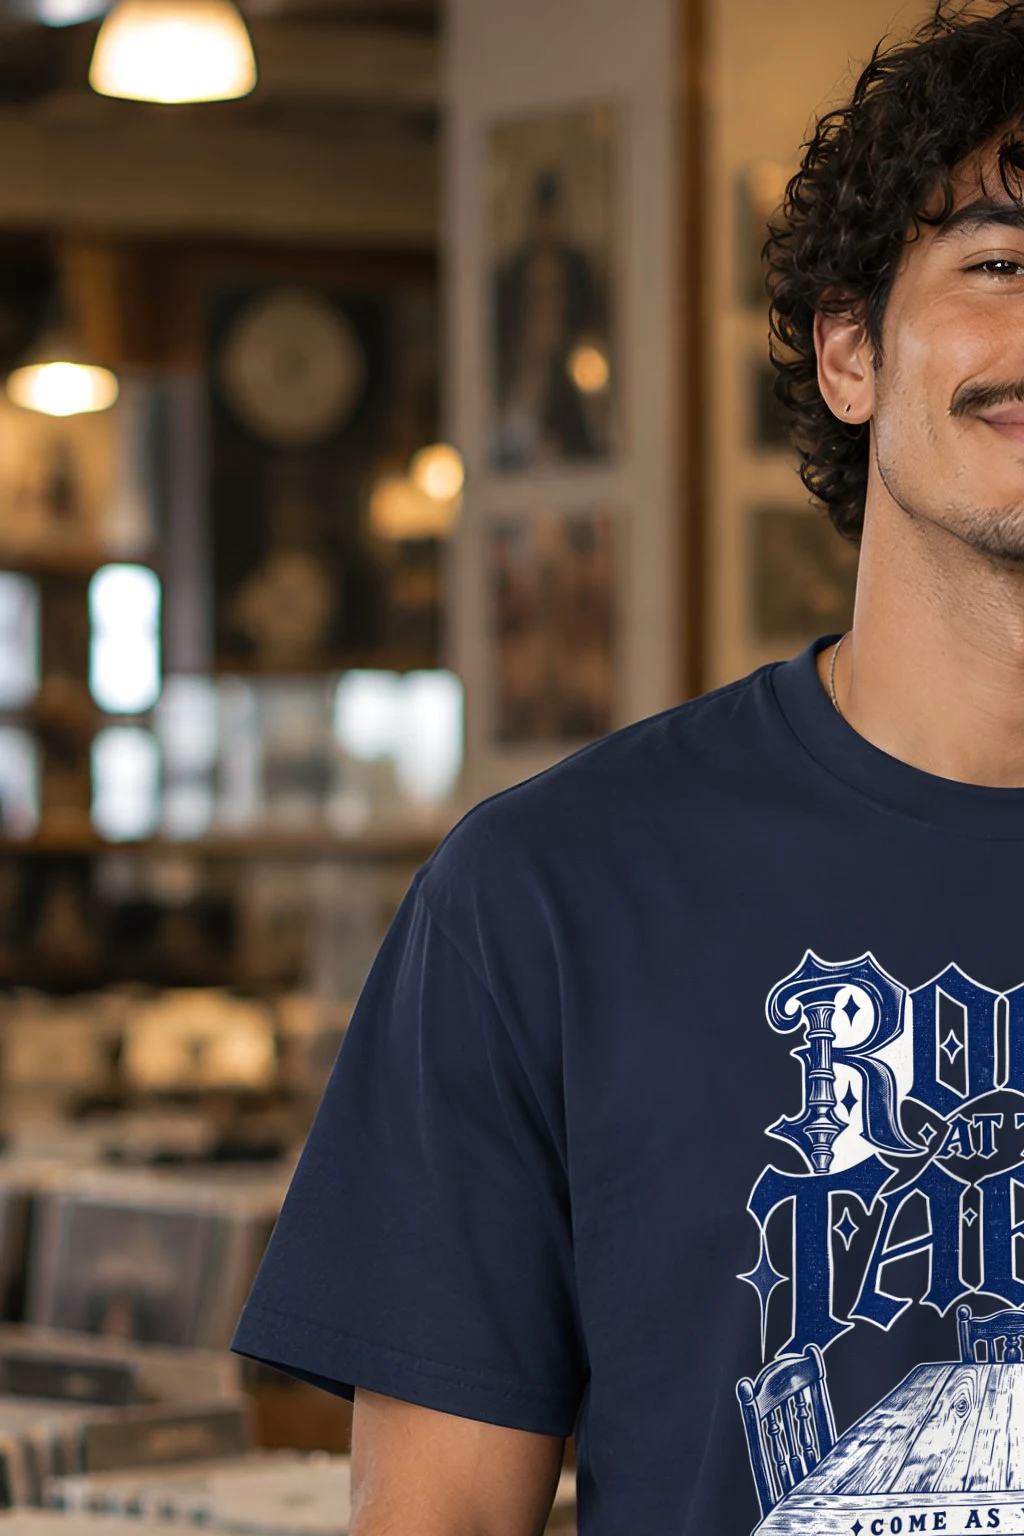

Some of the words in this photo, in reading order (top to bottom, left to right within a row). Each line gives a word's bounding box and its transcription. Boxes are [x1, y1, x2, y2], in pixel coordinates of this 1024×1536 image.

[936, 1113, 1004, 1159] AT
[870, 1512, 947, 1536] COME
[965, 1509, 1000, 1529] AS
